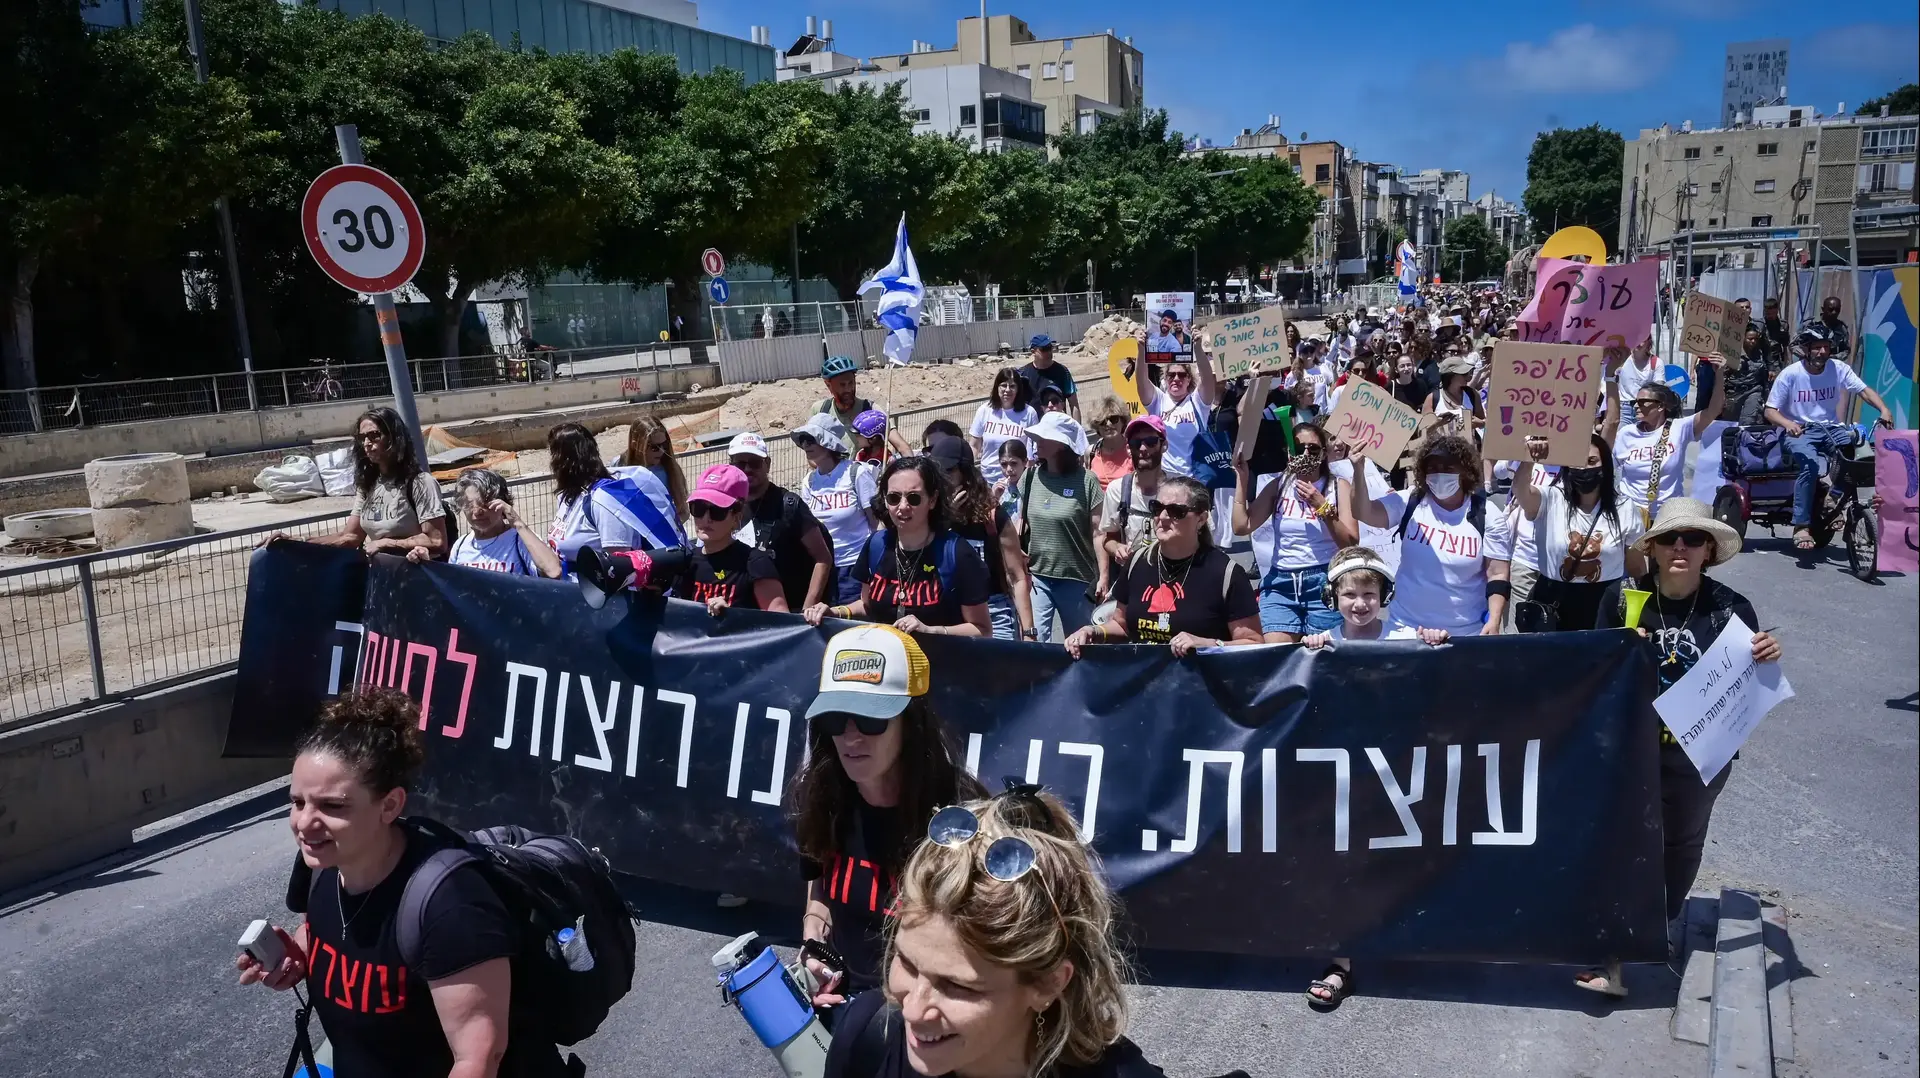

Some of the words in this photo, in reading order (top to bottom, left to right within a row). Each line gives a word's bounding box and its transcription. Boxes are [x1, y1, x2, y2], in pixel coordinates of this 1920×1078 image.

[333, 205, 394, 253] 30
[1552, 270, 1632, 311] עוצר
[1224, 316, 1260, 331] האוצר
[1566, 316, 1596, 328] את
[1214, 334, 1227, 347] על
[1232, 330, 1254, 343] שומר
[1263, 325, 1279, 338] לא
[1242, 342, 1279, 356] האוצר
[1228, 359, 1251, 374] שוב
[1263, 356, 1281, 366] הכי
[1505, 388, 1556, 406] שיפה
[1561, 392, 1587, 410] מה
[1793, 386, 1836, 402] עוצרות.
[984, 421, 1024, 438] עוצרות
[1336, 412, 1384, 450] בחינוך
[1521, 411, 1571, 433] עושה
[1204, 451, 1225, 465] RUBY
[1407, 522, 1479, 559] עוצרות.
[835, 657, 882, 675] NOTODAY
[1722, 646, 1733, 673] לא
[1699, 669, 1722, 697] אומר
[494, 661, 697, 789] רוצות
[1142, 739, 1541, 853] עוצרות.
[306, 921, 406, 1014] עוצרו
[811, 1031, 828, 1054] OXTONE
